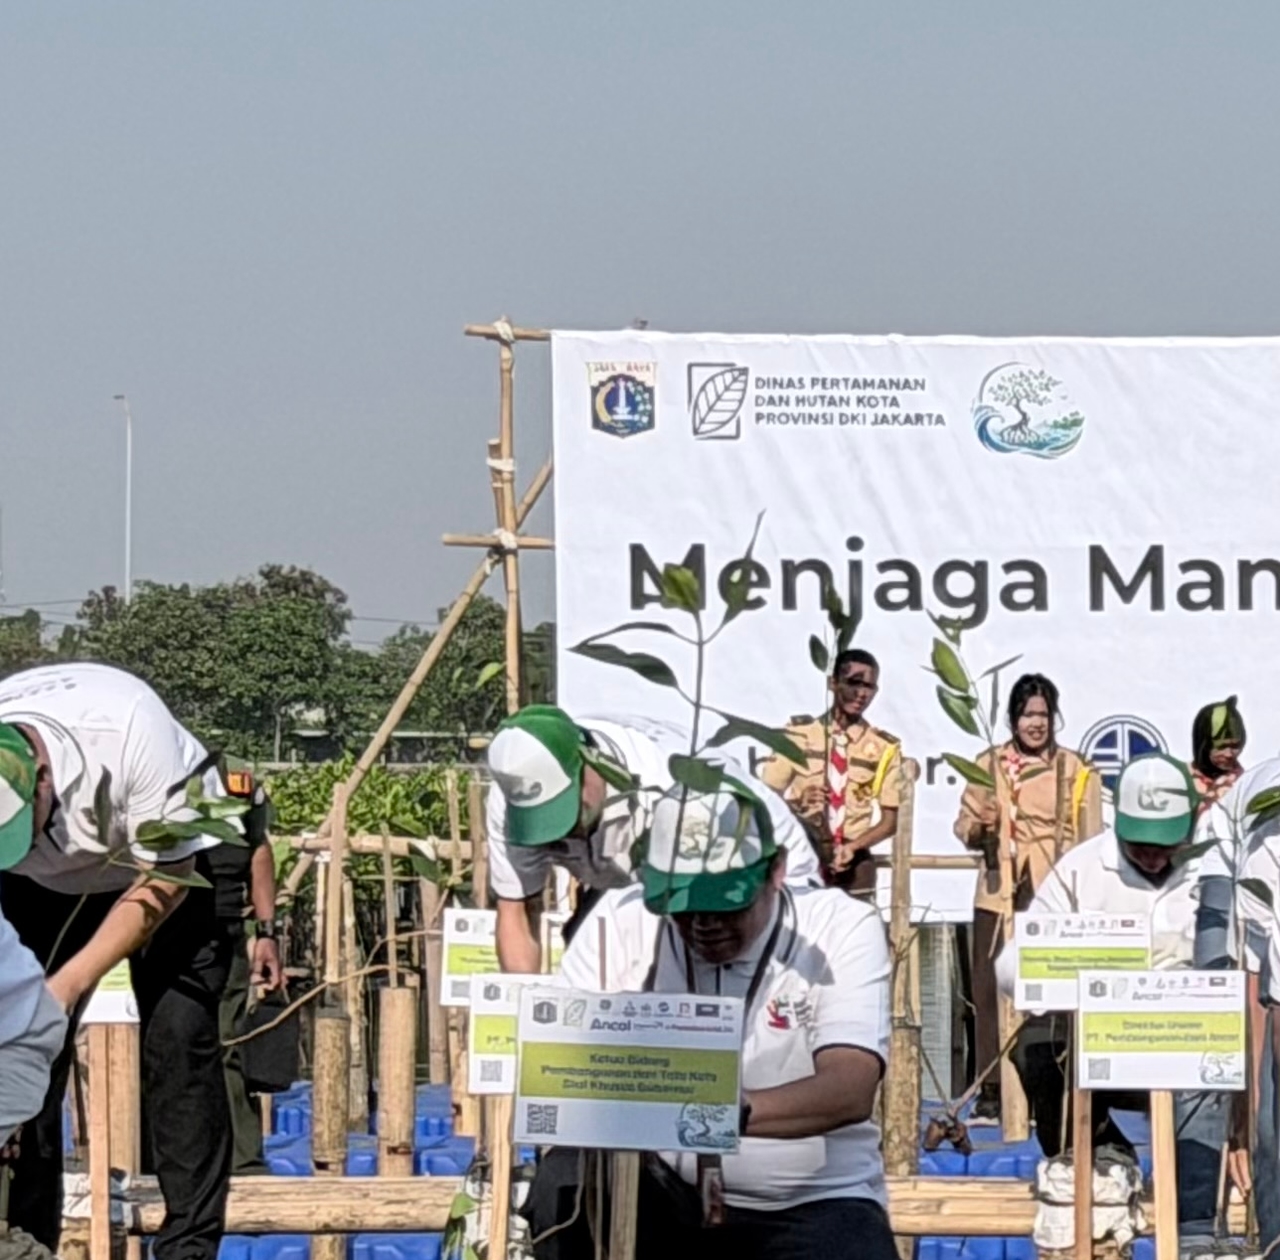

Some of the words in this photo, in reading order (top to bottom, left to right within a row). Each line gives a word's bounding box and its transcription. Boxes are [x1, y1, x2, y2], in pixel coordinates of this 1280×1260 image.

[754, 377, 805, 390] DINAS
[810, 377, 926, 390] PERTAMANAN
[755, 395, 790, 407] DAN
[795, 395, 850, 407] HUTAN
[856, 396, 901, 408] KOTA
[755, 411, 834, 425] PROVINSI
[839, 412, 867, 425] DKI
[870, 412, 947, 426] JAKARTA
[627, 535, 1048, 631] Menjaga
[590, 1017, 631, 1032] Ancol
